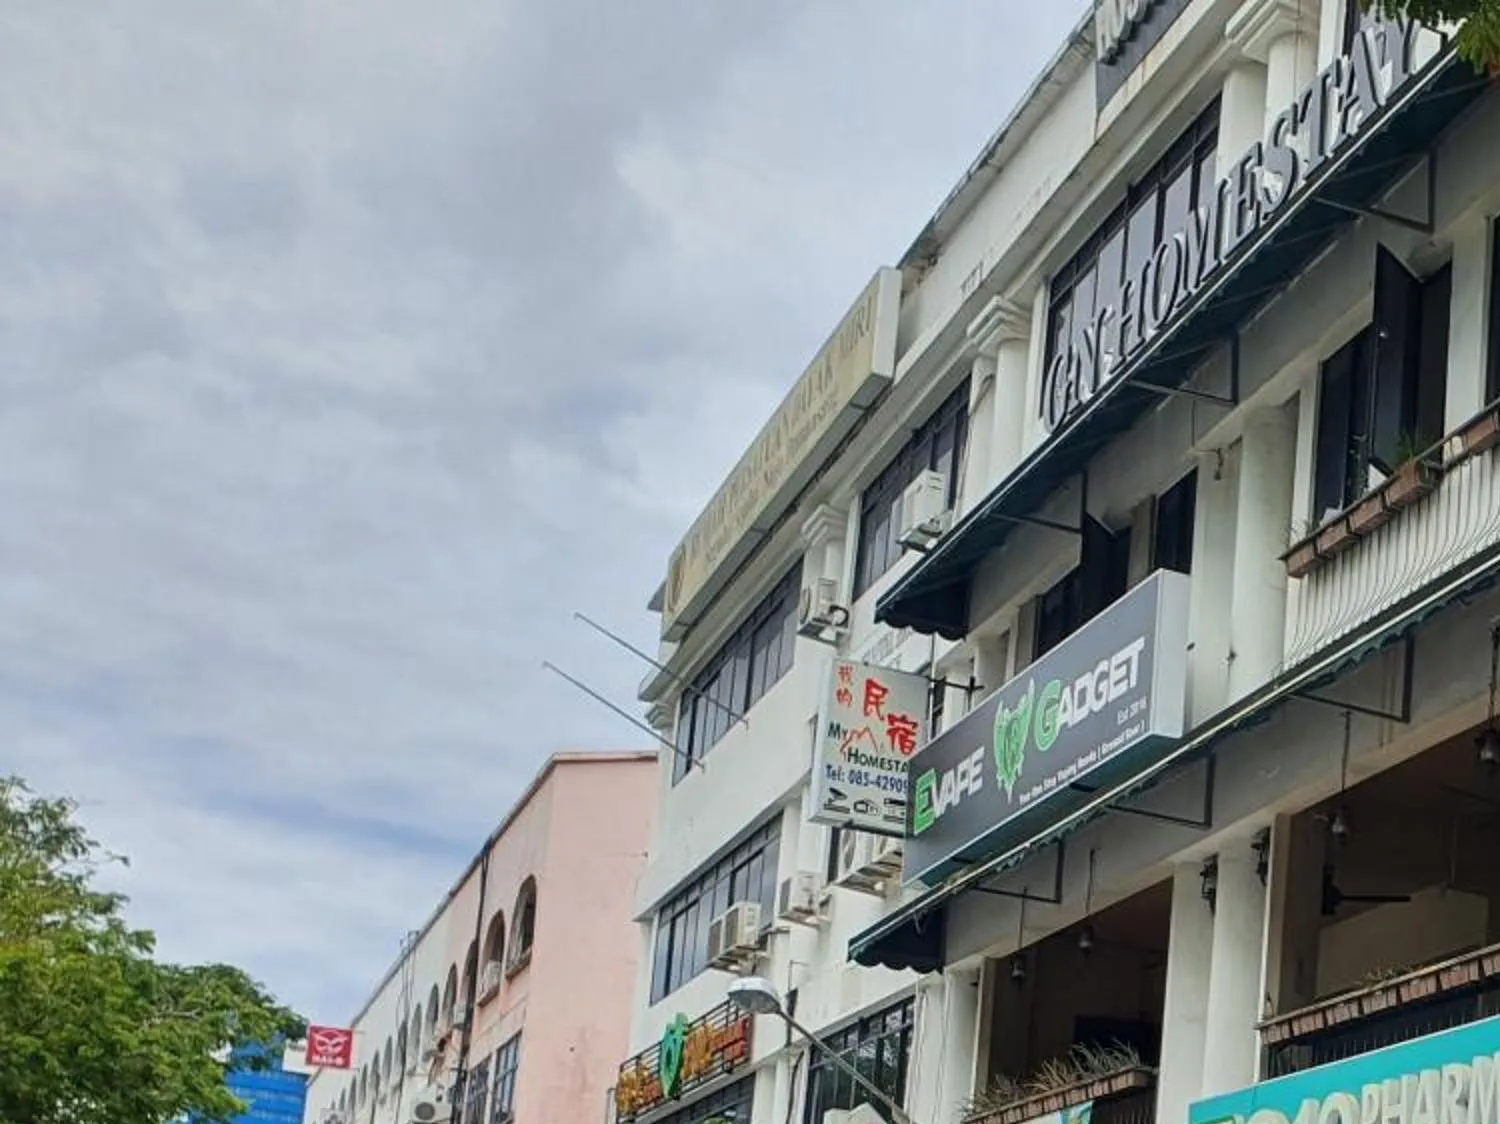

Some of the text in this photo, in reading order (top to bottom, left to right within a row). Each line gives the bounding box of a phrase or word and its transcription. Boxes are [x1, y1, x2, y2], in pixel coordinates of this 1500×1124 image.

[864, 678, 918, 756] 民宿
[1034, 636, 1146, 751] GADGET
[847, 747, 909, 773] HOMESTA
